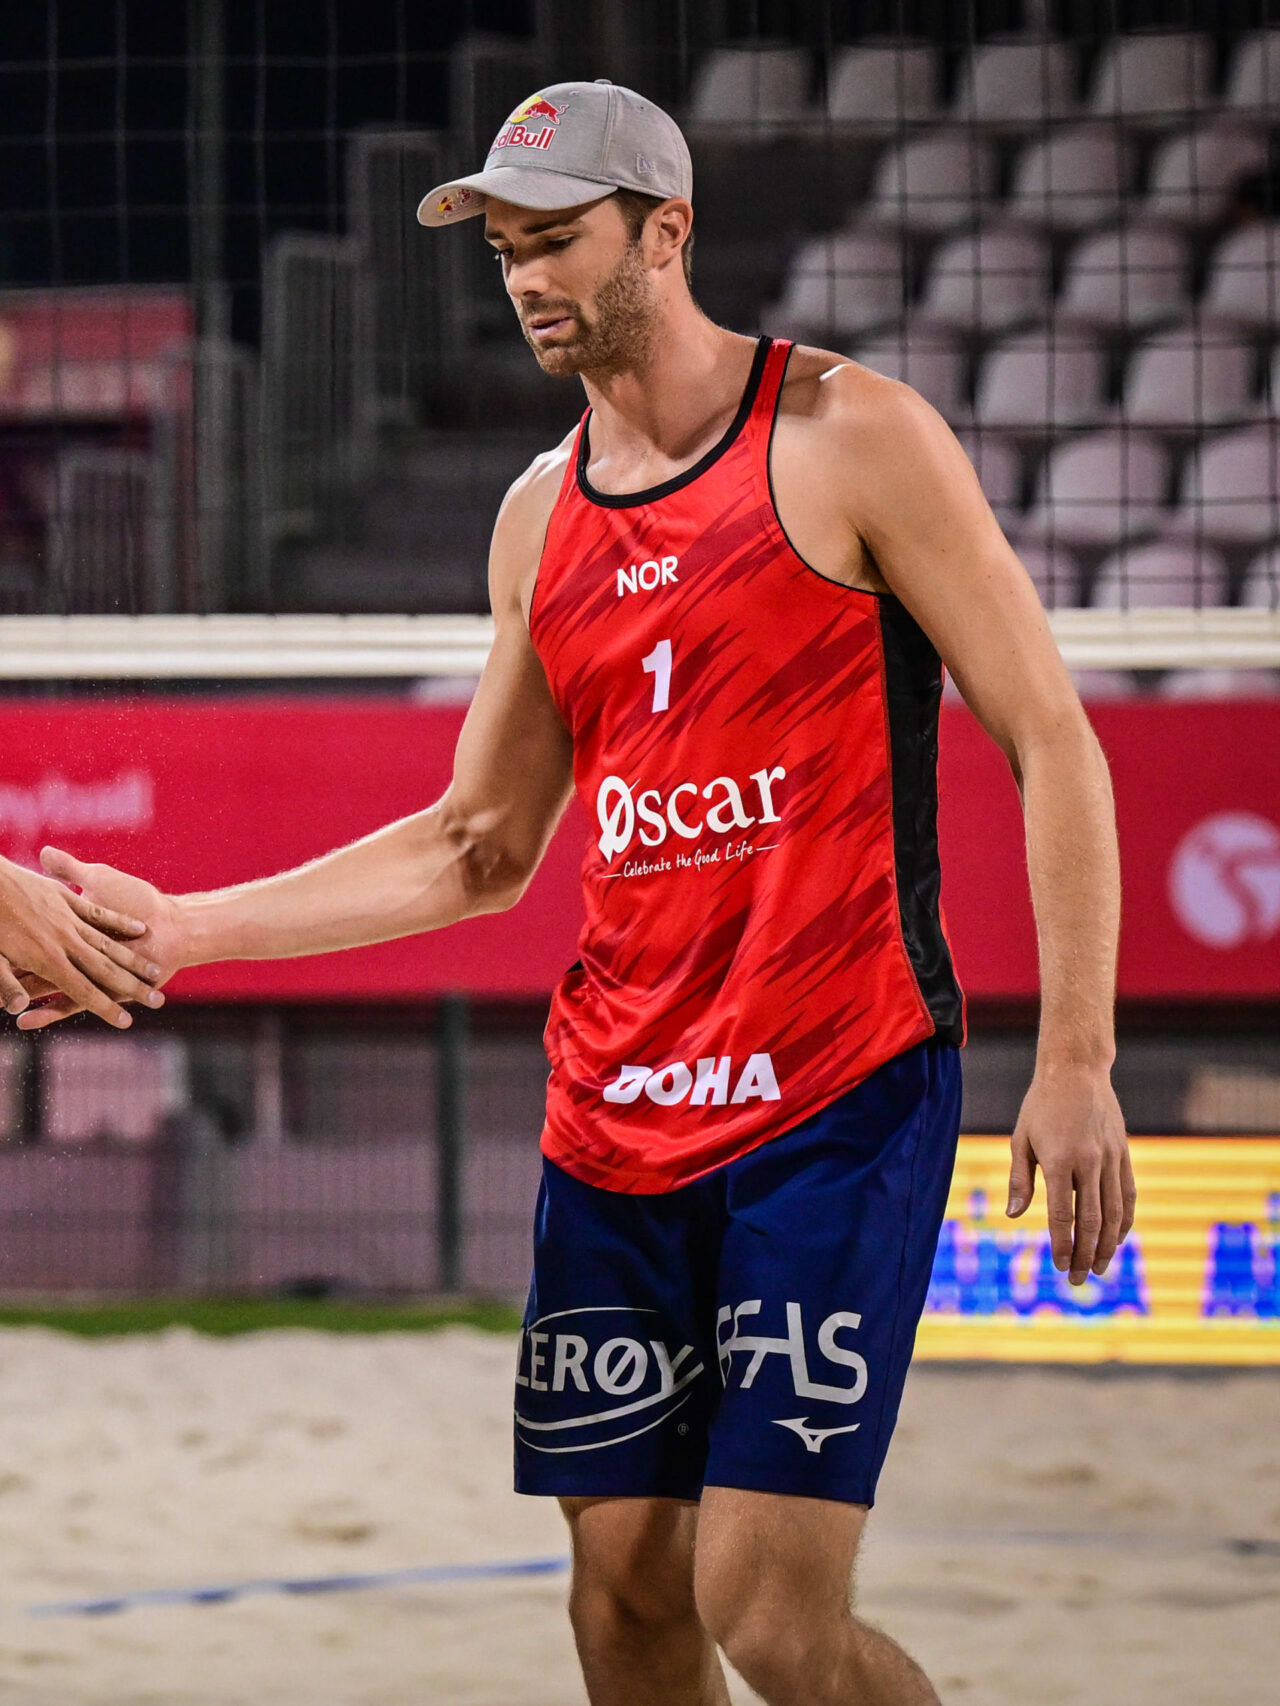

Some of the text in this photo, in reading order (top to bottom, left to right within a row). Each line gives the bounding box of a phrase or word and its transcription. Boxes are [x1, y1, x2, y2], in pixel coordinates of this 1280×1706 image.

[507, 122, 556, 151] Bull
[616, 555, 679, 597] NOR
[641, 638, 673, 714] 1
[623, 840, 754, 878] Celebrate the Good Life
[603, 1052, 782, 1106] DOHA
[515, 1327, 694, 1396] LERØY
